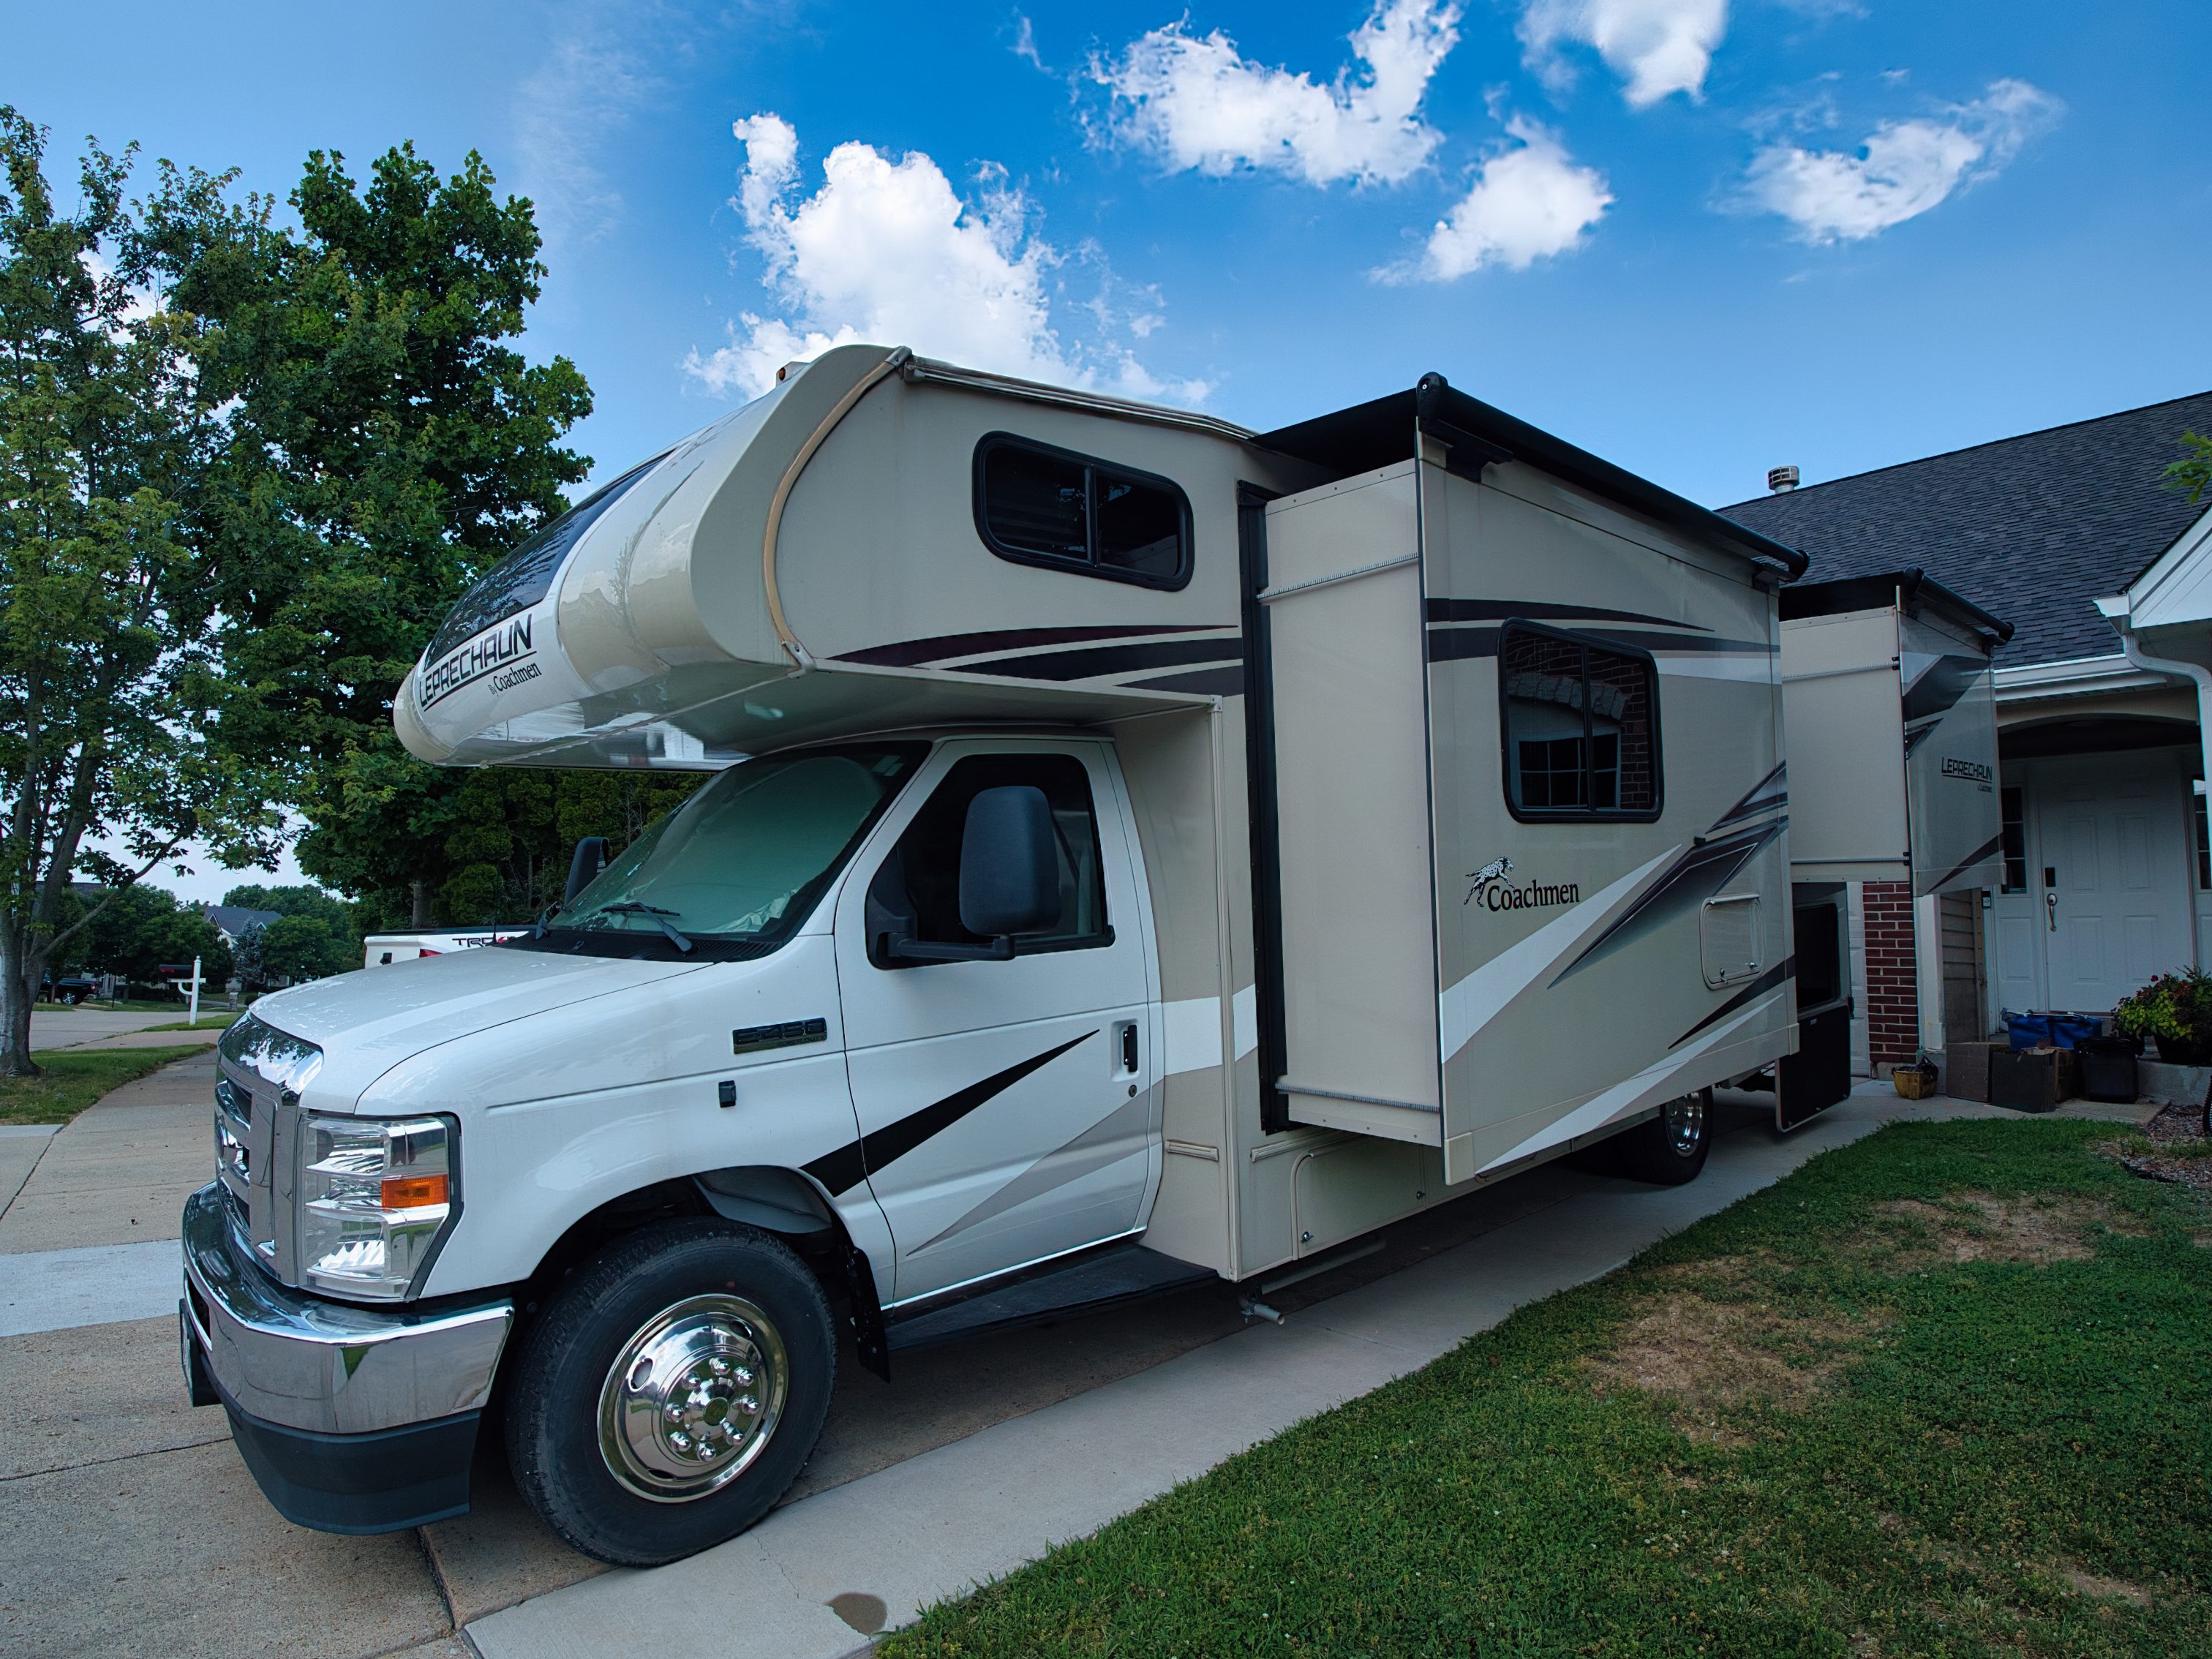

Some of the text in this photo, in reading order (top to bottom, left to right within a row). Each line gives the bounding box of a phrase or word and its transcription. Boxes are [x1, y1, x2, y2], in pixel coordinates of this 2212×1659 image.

[419, 614, 533, 707] LEPRECHAUN
[488, 663, 542, 697] By Coachmen
[1941, 756, 1993, 780] LEPRECHAUN
[1487, 879, 1579, 911] Coachmen
